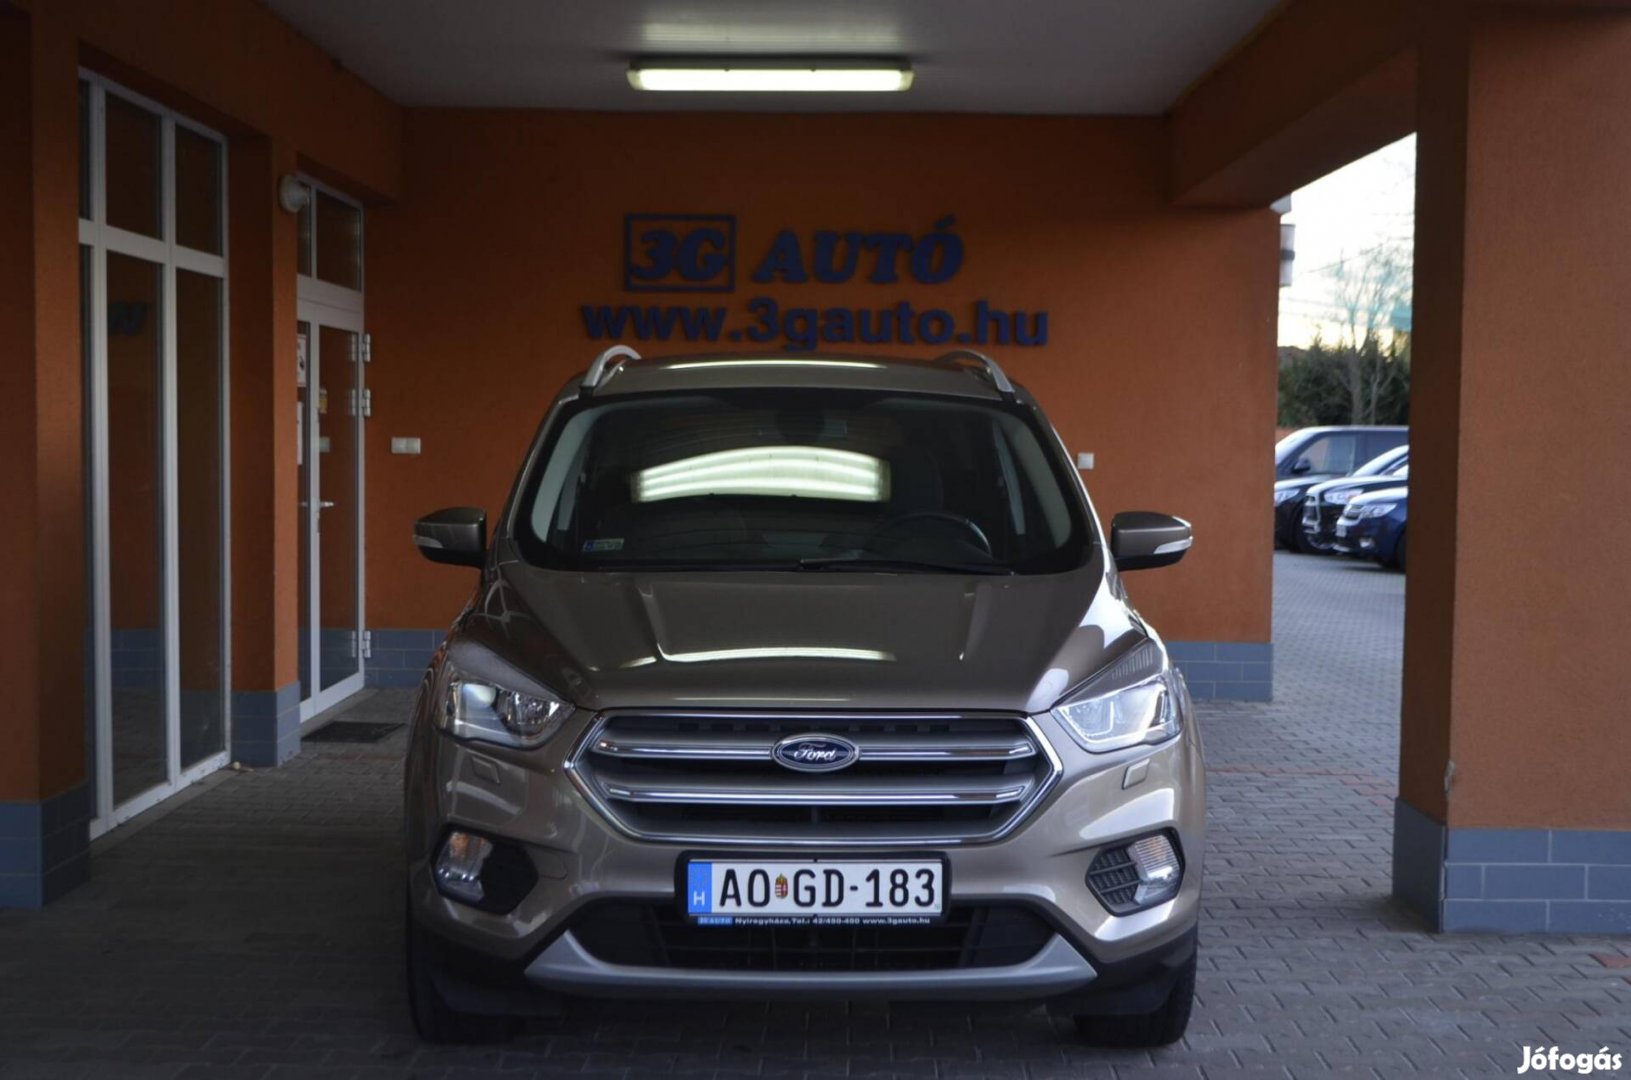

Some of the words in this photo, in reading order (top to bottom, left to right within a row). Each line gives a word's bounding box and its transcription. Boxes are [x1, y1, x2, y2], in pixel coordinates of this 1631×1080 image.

[630, 227, 729, 282] 3G
[752, 214, 965, 284] AUTÓ
[581, 296, 1048, 352] www.3gauto.hu
[793, 742, 837, 761] Ford
[693, 890, 706, 906] H
[719, 868, 771, 908] AO
[793, 868, 936, 908] GD-183
